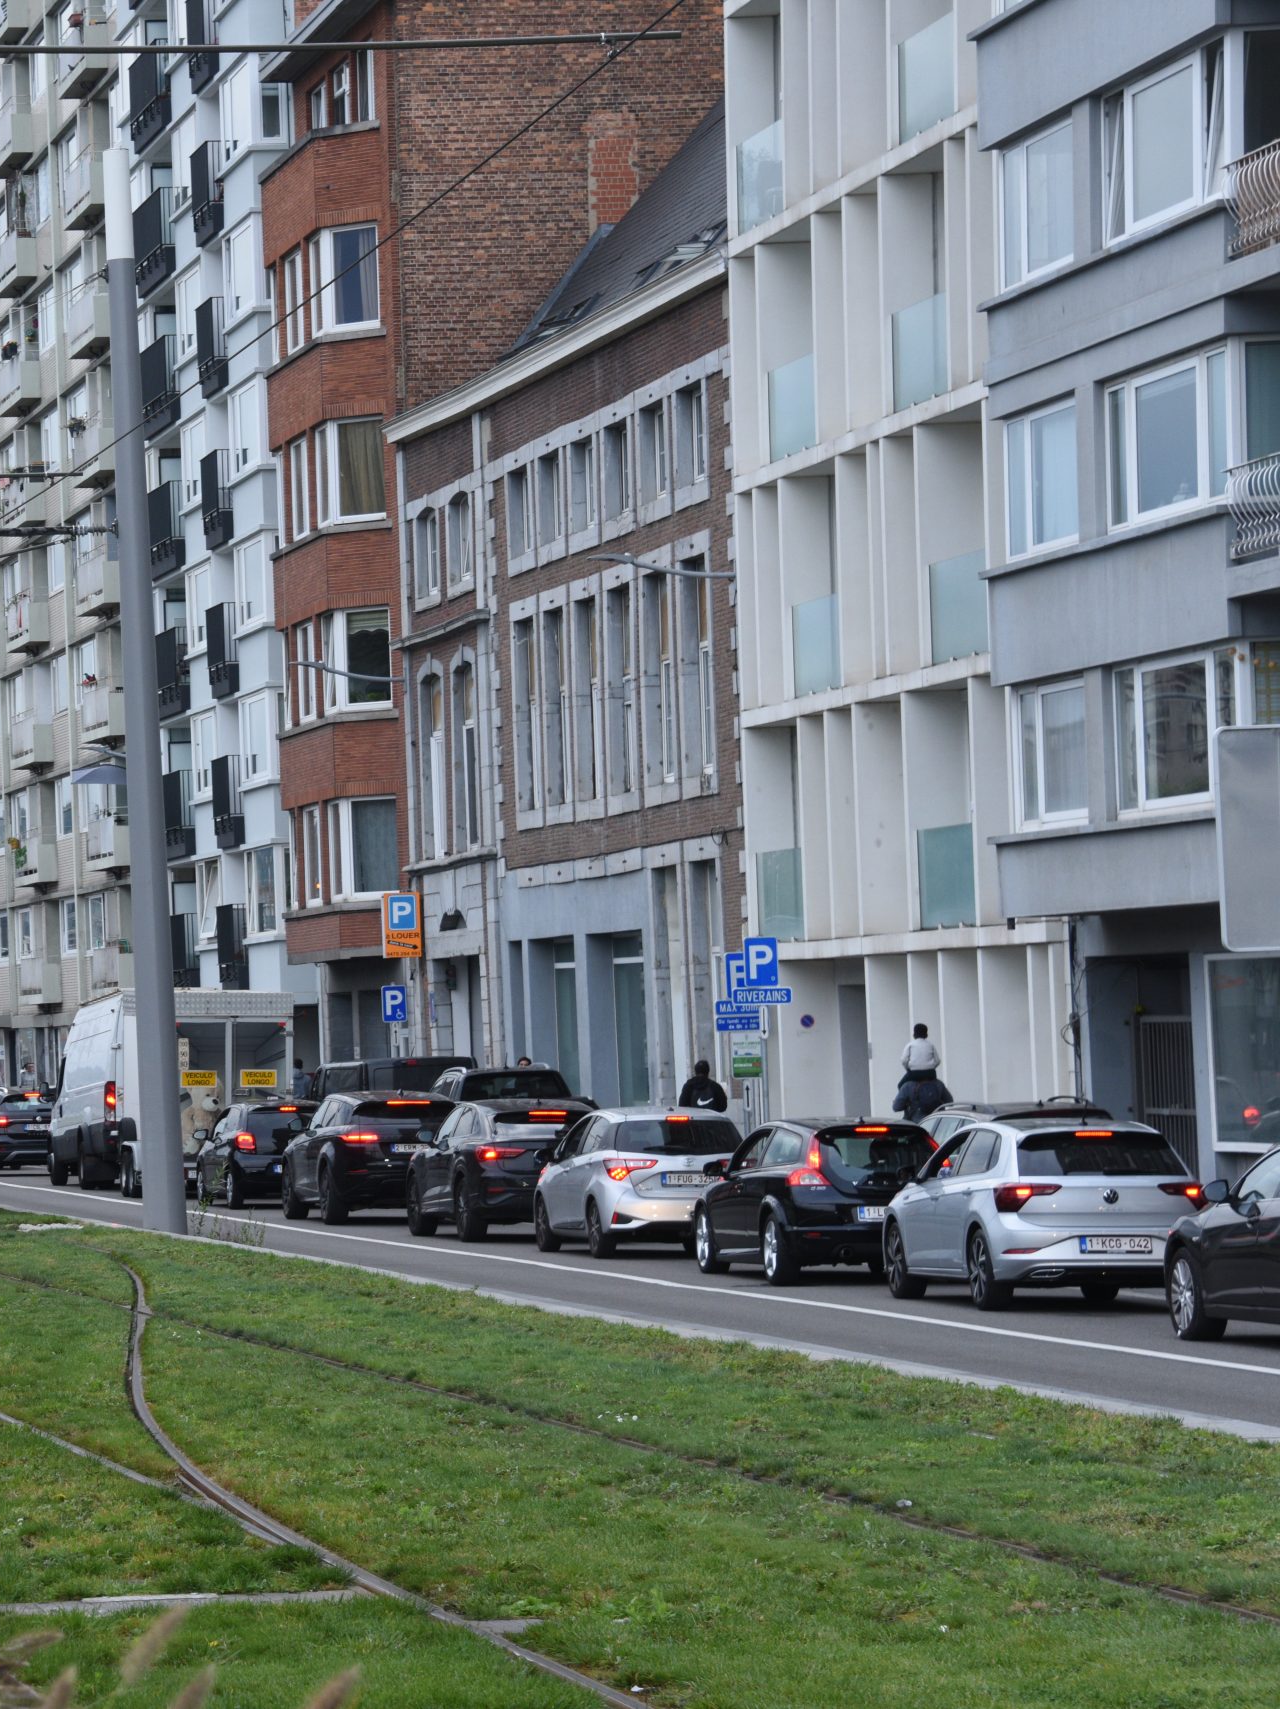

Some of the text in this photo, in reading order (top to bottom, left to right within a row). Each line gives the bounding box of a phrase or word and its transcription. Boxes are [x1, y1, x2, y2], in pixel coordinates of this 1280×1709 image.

[392, 902, 412, 924] P
[749, 945, 773, 980] P
[385, 990, 403, 1016] P
[736, 990, 787, 1003] RIVERAINS
[720, 1004, 737, 1013] MAX
[1088, 1238, 1150, 1249] 1-KCG-042
